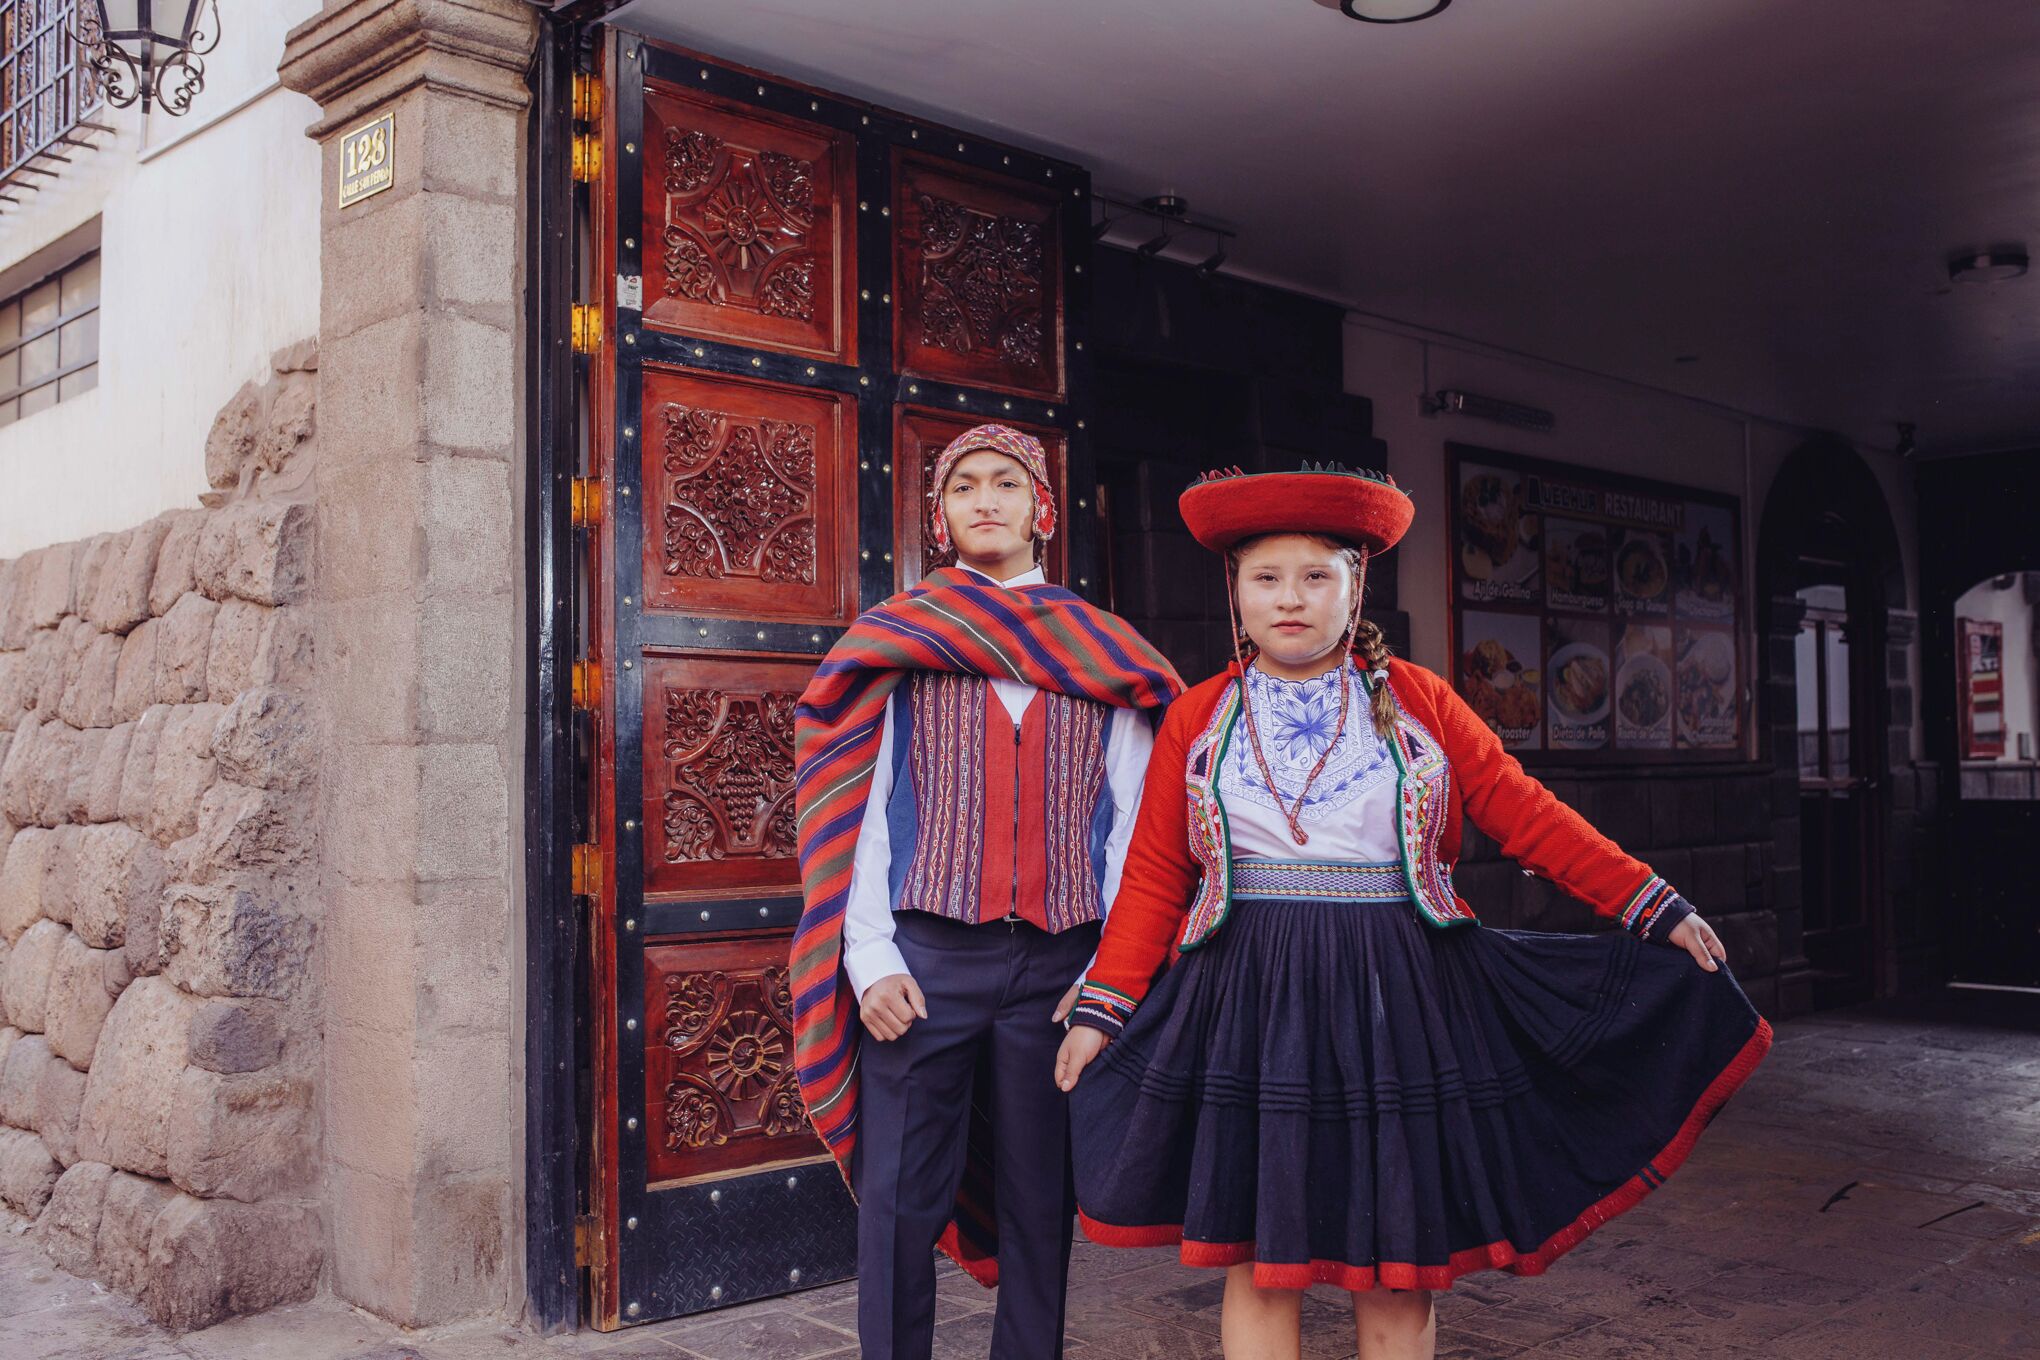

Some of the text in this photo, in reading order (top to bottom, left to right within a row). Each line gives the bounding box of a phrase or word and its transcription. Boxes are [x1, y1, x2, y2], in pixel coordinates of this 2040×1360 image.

[347, 127, 386, 178] 128
[1604, 492, 1682, 530] RESTAURANT
[1498, 724, 1531, 740] Broaster
[1553, 726, 1574, 740] Dieta
[1575, 727, 1586, 740] de
